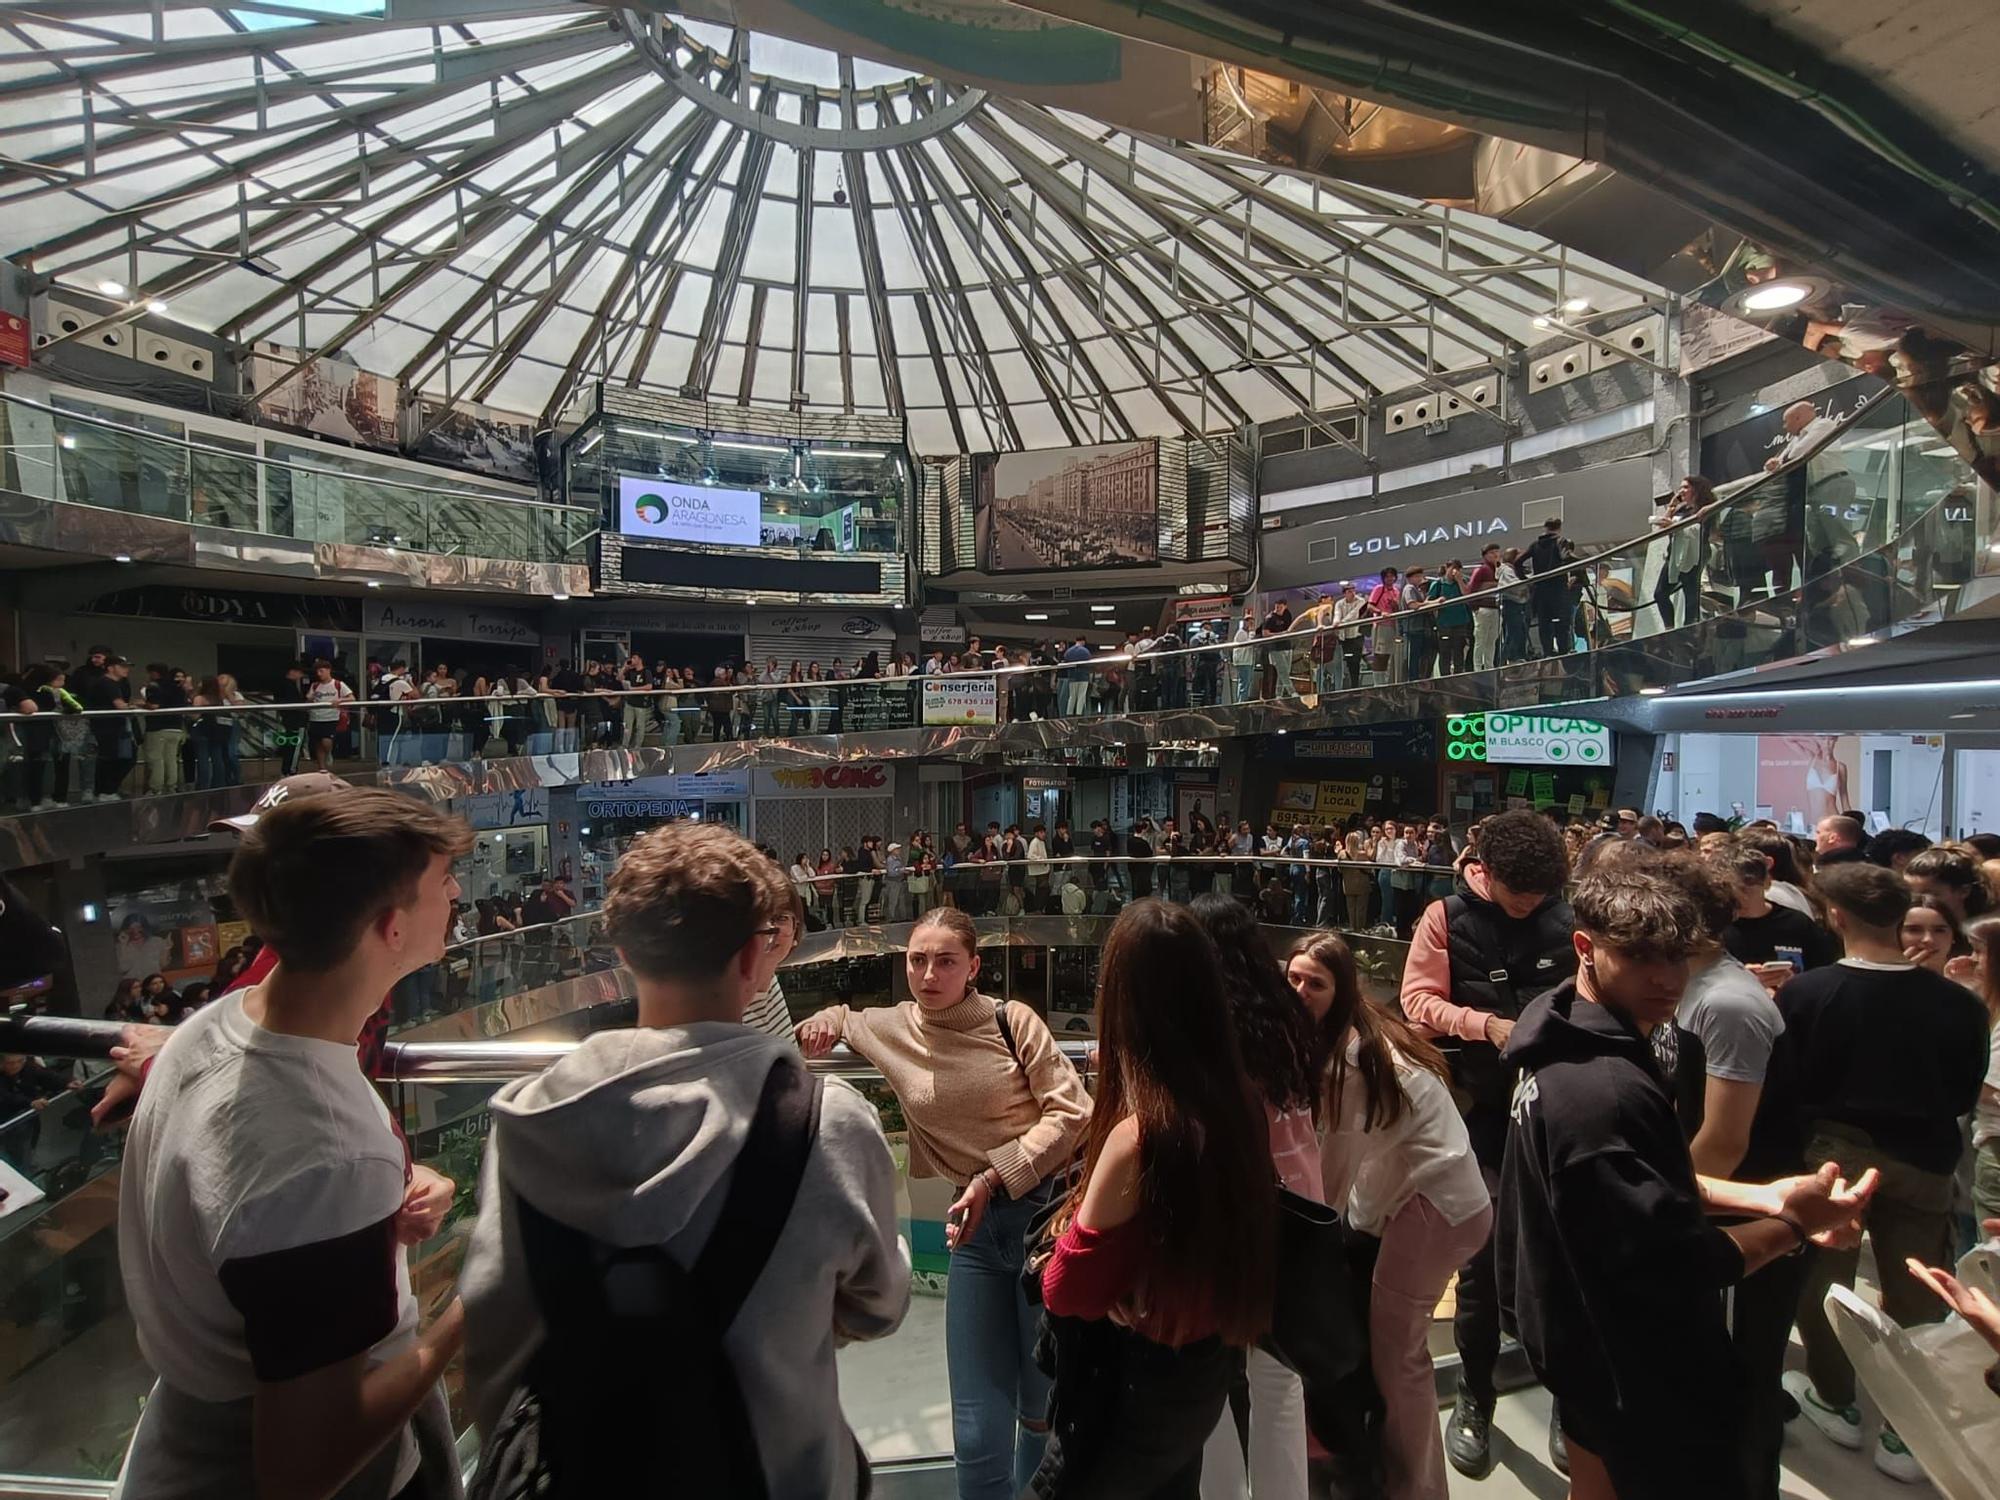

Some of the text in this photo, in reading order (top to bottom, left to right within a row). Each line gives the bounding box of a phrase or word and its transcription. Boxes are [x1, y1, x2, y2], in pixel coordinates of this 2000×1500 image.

[672, 496, 711, 511] ONDA
[672, 510, 748, 526] ARAGONESA
[1348, 517, 1509, 557] SOLMANIA
[380, 605, 448, 629] Aurora
[1501, 738, 1544, 747] BLASCO
[1028, 779, 1067, 787] FOTOMATON
[1323, 785, 1360, 794] VENDO
[589, 801, 690, 818] ORTOPEDIA
[1323, 797, 1357, 807] LOCAL
